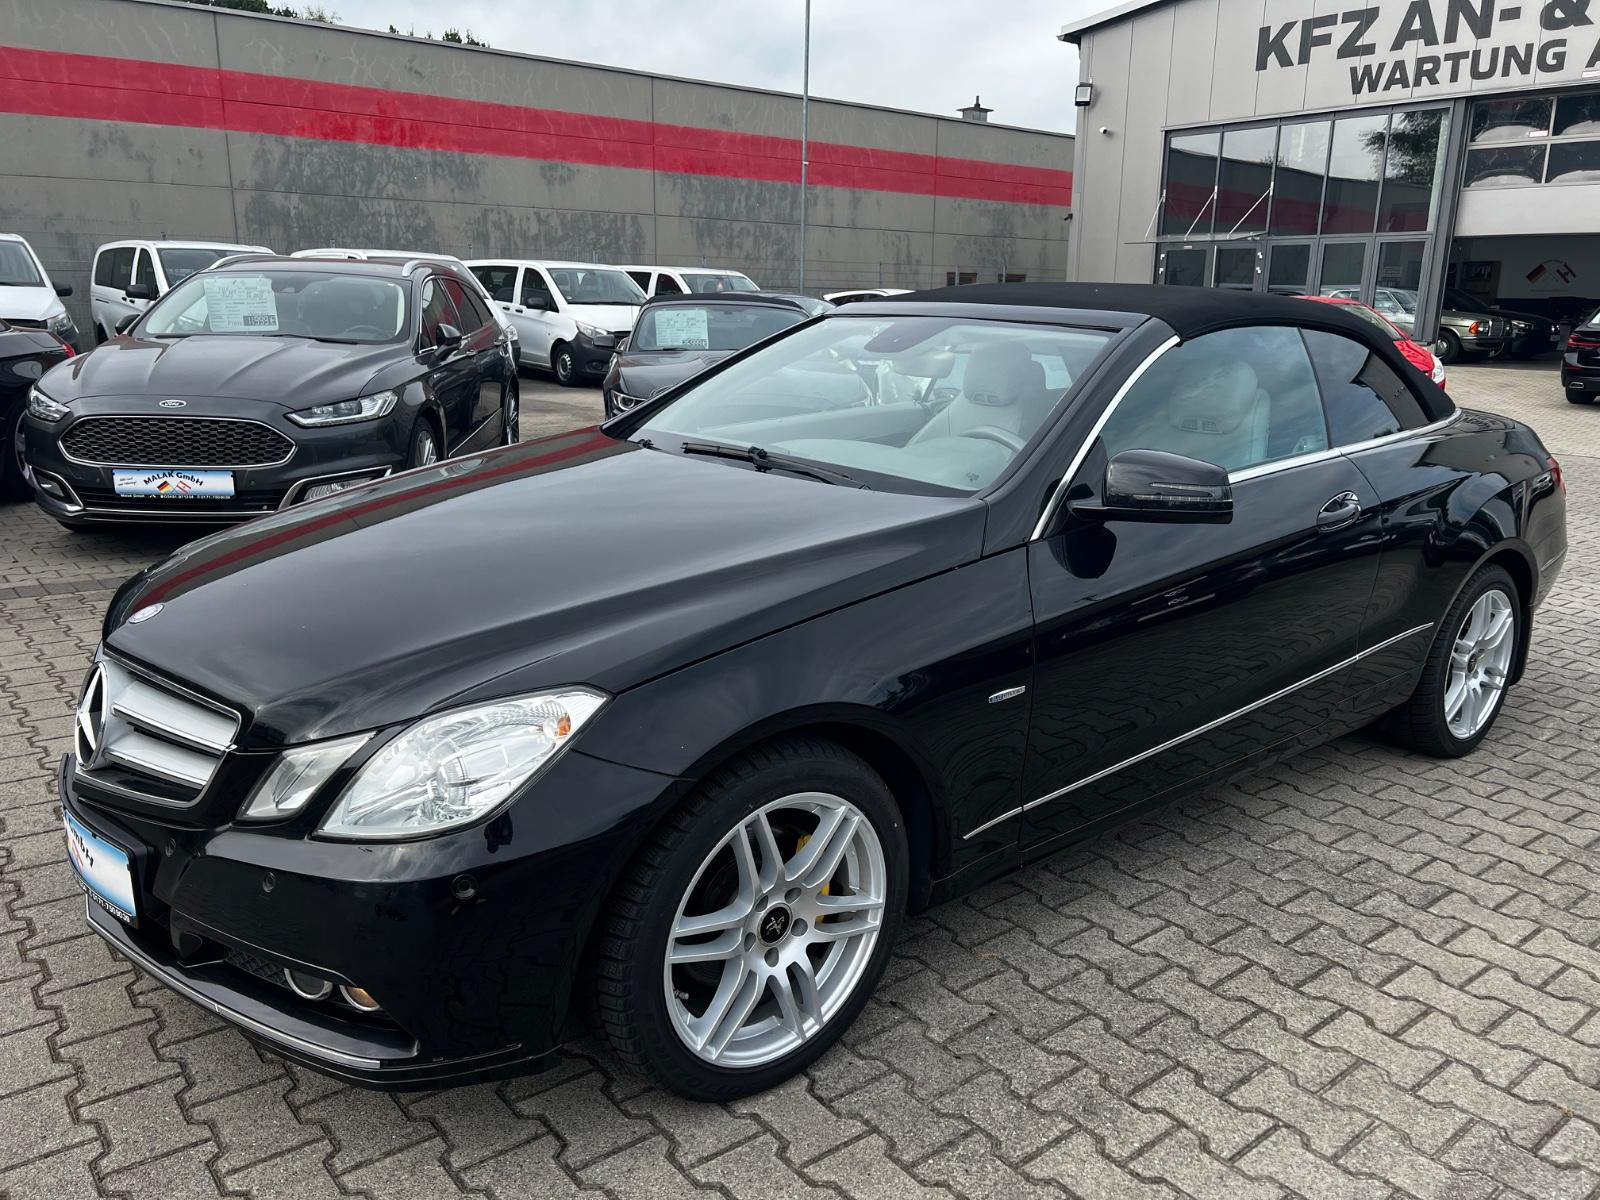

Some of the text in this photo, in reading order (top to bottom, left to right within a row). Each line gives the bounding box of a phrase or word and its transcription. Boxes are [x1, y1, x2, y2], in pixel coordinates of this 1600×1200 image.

[1255, 6, 1380, 71] KFZ
[1350, 38, 1568, 95] WARTUNG
[143, 471, 174, 485] MALAK
[175, 471, 204, 486] GmbH
